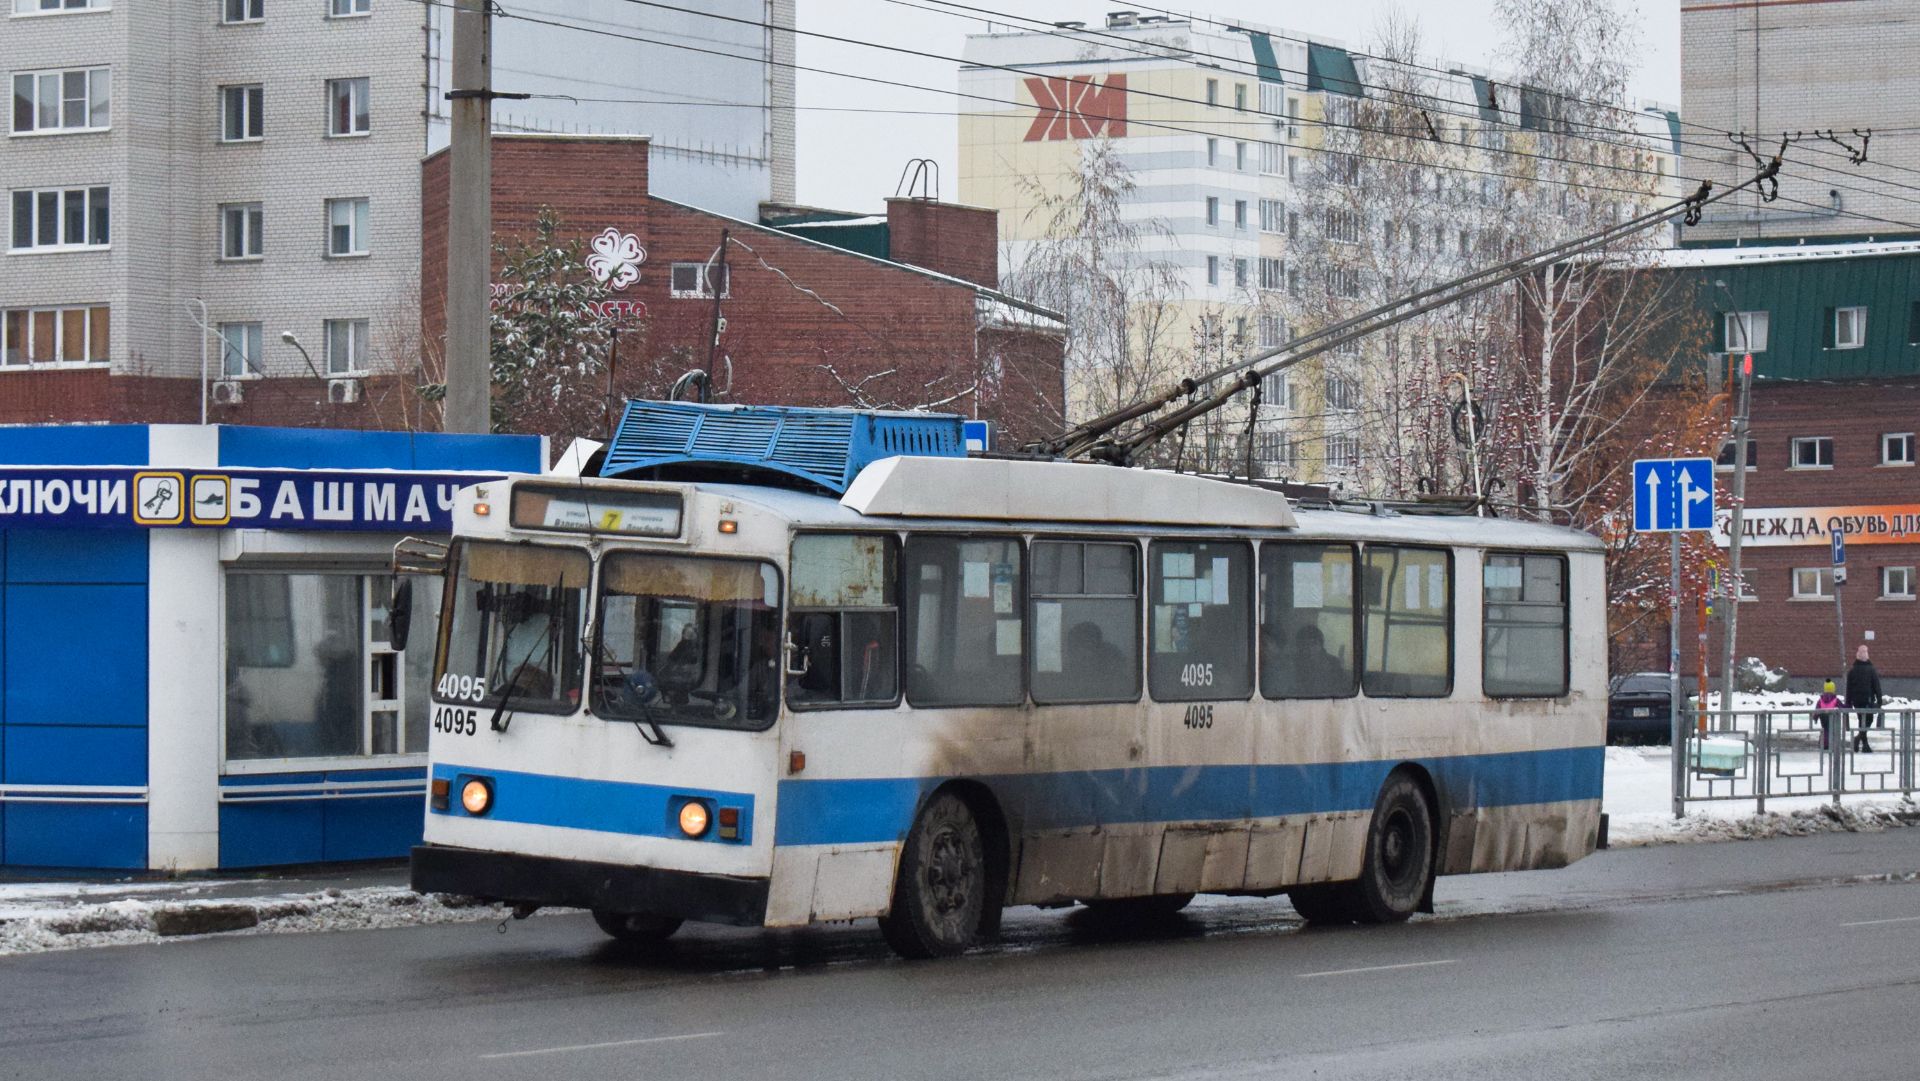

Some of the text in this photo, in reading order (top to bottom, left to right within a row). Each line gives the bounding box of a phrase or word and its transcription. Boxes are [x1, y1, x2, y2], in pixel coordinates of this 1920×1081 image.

[229, 476, 460, 522] БАШМАЧ
[607, 513, 618, 529] 7
[437, 673, 485, 702] 4095
[1181, 663, 1213, 687] 4095
[434, 707, 477, 736] 4095
[1184, 705, 1213, 729] 4095
